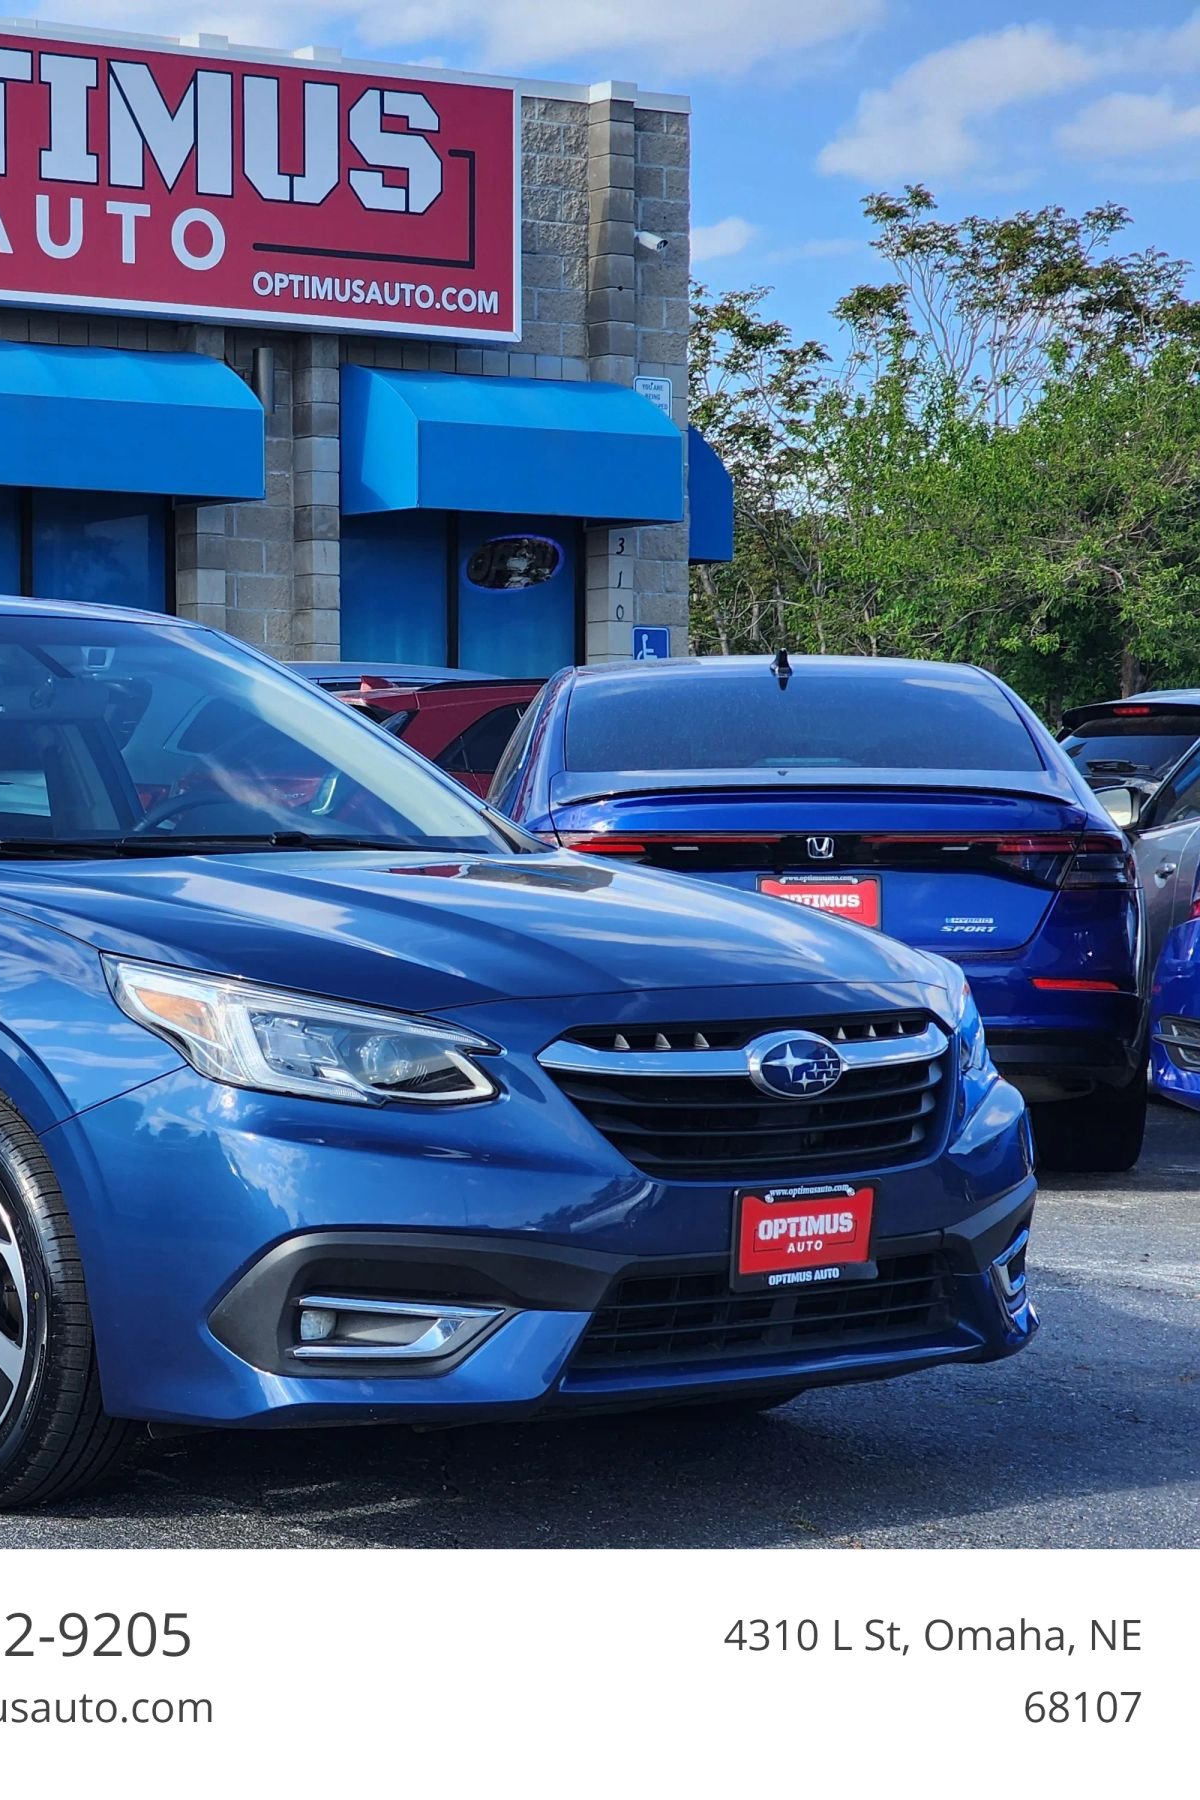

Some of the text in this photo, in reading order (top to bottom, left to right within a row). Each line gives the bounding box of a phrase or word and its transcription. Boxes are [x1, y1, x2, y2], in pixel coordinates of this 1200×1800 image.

[252, 270, 499, 315] OPTIMUSAUTO.COM
[940, 925, 998, 933] SPORT
[769, 1184, 850, 1198] www.optimusauto.com
[757, 1211, 854, 1241] OPTIMUS
[787, 1240, 824, 1254] AUTO
[768, 1267, 840, 1286] OPTIMUS AUTO
